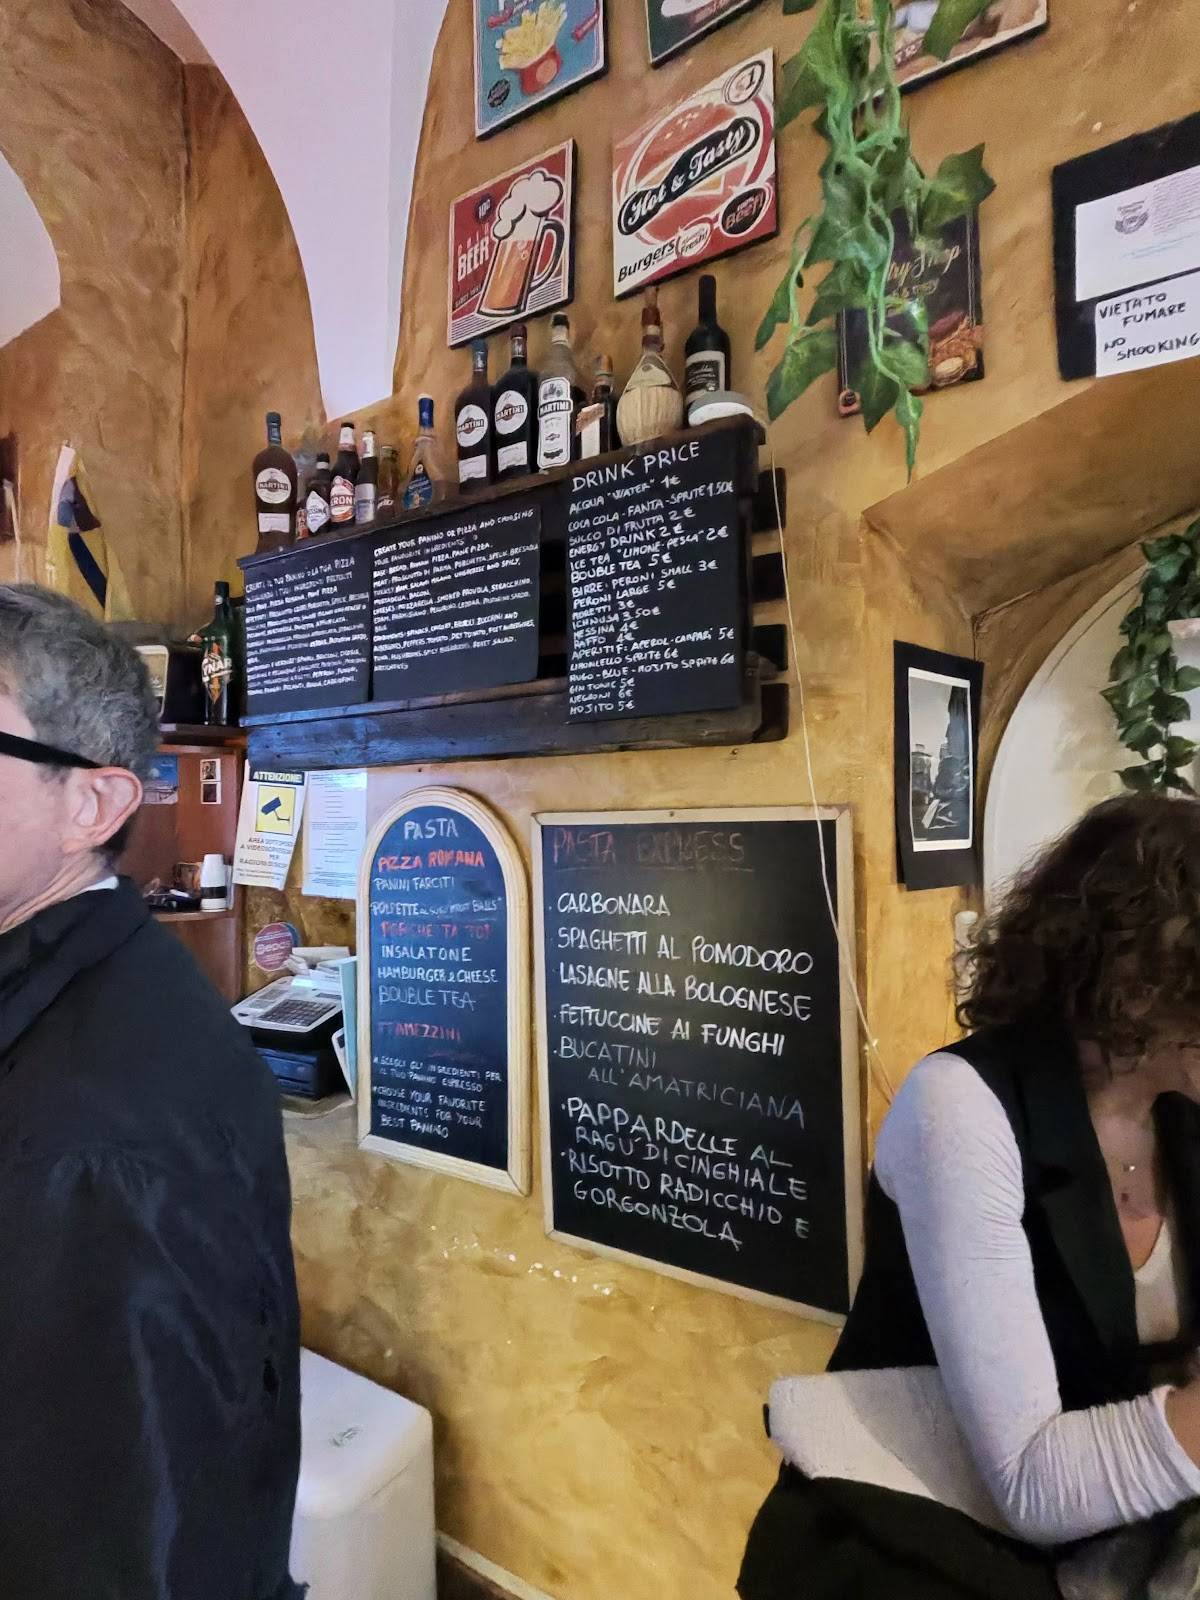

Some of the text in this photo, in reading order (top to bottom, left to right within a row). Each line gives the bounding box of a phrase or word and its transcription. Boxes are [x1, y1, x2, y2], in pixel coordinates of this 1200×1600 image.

[627, 122, 746, 227] Hot & Tasty
[457, 236, 490, 282] BEER
[618, 237, 675, 283] Burgers
[1099, 292, 1167, 320] VIETATO
[1121, 302, 1186, 328] FUMARE
[1104, 337, 1126, 353] NO
[572, 442, 700, 492] DRINK PRICE
[569, 496, 605, 514] ACQUA
[568, 518, 590, 532] COCA
[593, 512, 619, 526] COLA
[569, 532, 601, 546] SUCCO
[607, 526, 620, 535] DI
[625, 515, 664, 532] FRUTTA
[374, 543, 397, 557] CREATE
[480, 518, 495, 528] AND
[569, 542, 605, 558] ENERGY
[610, 529, 656, 548] DRINK
[570, 559, 586, 571] ICE
[590, 554, 610, 565] TEA
[619, 560, 641, 571] TEA
[612, 574, 655, 589] PERONI
[661, 564, 692, 579] SMALL
[573, 594, 612, 609] PERONI
[616, 585, 650, 599] LARGE
[572, 605, 611, 620] MORETTI
[572, 613, 619, 630] ICHNUSA
[573, 625, 615, 640] MESSINA
[574, 637, 606, 650] RAFFO
[569, 684, 584, 692] GIN
[588, 681, 616, 690] TONIC
[569, 692, 610, 703] NEGRONI
[570, 703, 614, 715] MOJITO
[404, 818, 459, 840] PASTA
[378, 850, 485, 872] PIZZA ROMANA
[374, 877, 410, 891] PANINI
[557, 892, 671, 917] CARBONARA
[381, 946, 472, 961] INSALATONE
[557, 927, 814, 976] SPAGHETTI AL POMODORO
[378, 966, 445, 982] HAMBURGER
[456, 969, 499, 983] CHEESE
[438, 989, 476, 1011] TEA
[559, 962, 812, 1023] LASAGNE ALLA BOLOGNESE
[559, 1003, 786, 1057] FETTUCCINE AI FUNGHI
[558, 1036, 657, 1069] BUCATINI
[567, 1097, 793, 1170] PAPPARDELLE AL
[642, 1143, 668, 1165] DI
[675, 1154, 808, 1200] CINGHIALE
[569, 1150, 810, 1239] RISOTTO RADICCHIO E
[574, 1179, 743, 1252] GORGONZOLA
